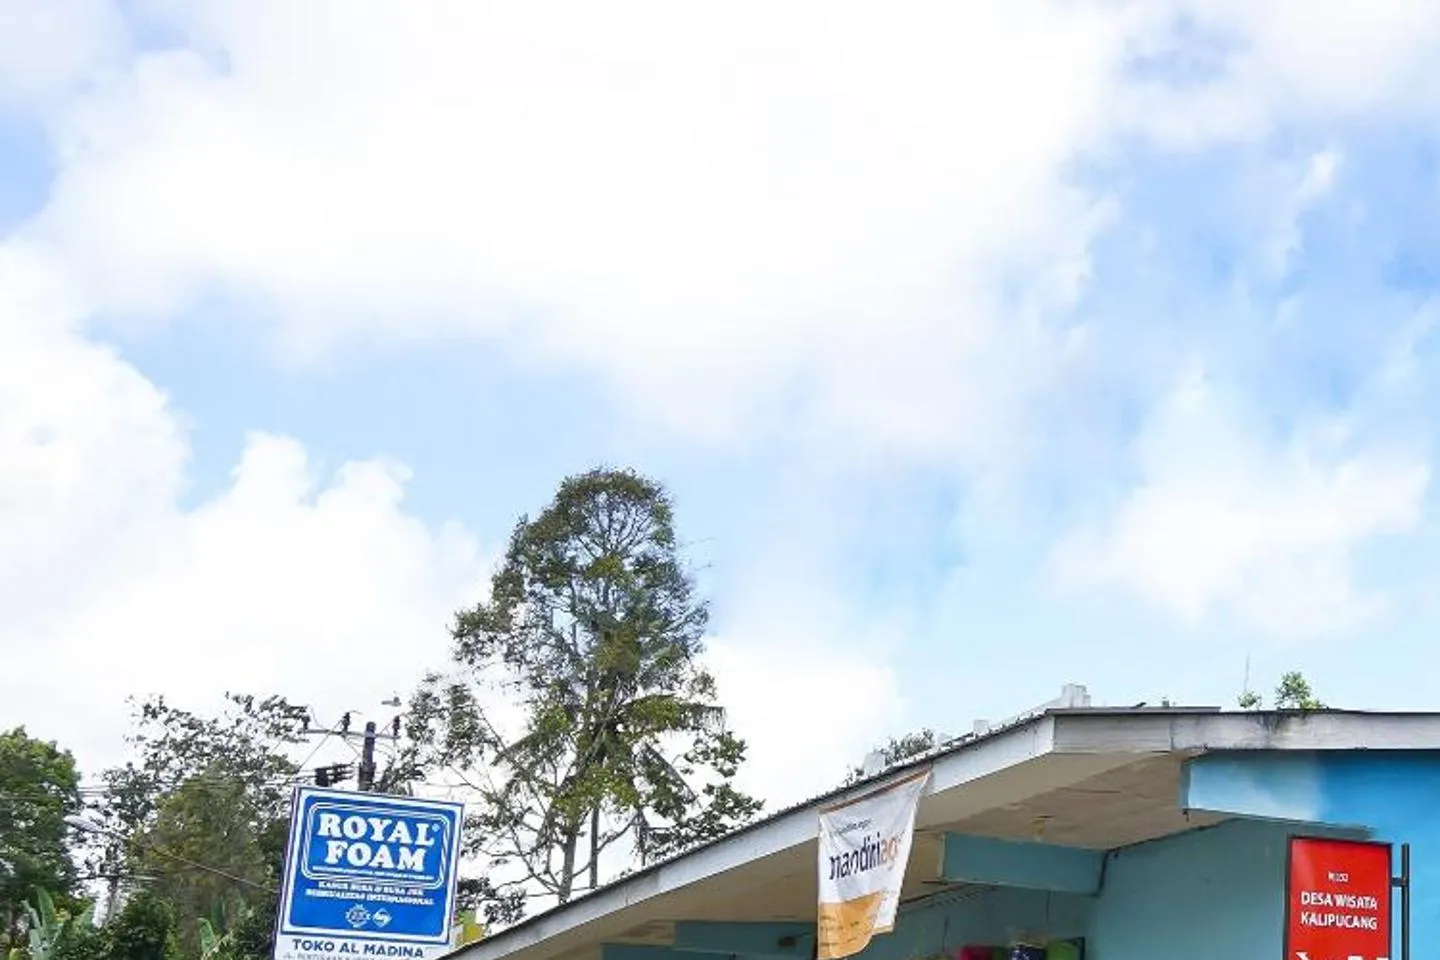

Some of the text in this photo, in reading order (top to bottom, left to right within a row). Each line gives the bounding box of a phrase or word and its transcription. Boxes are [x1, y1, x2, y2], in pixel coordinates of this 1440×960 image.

[317, 813, 435, 846] ROYAL
[324, 840, 427, 872] FOAM
[1301, 891, 1378, 910] DESA WISATA
[1300, 911, 1378, 930] KALIPUCANG
[292, 938, 424, 958] TOKO AL MADINA
